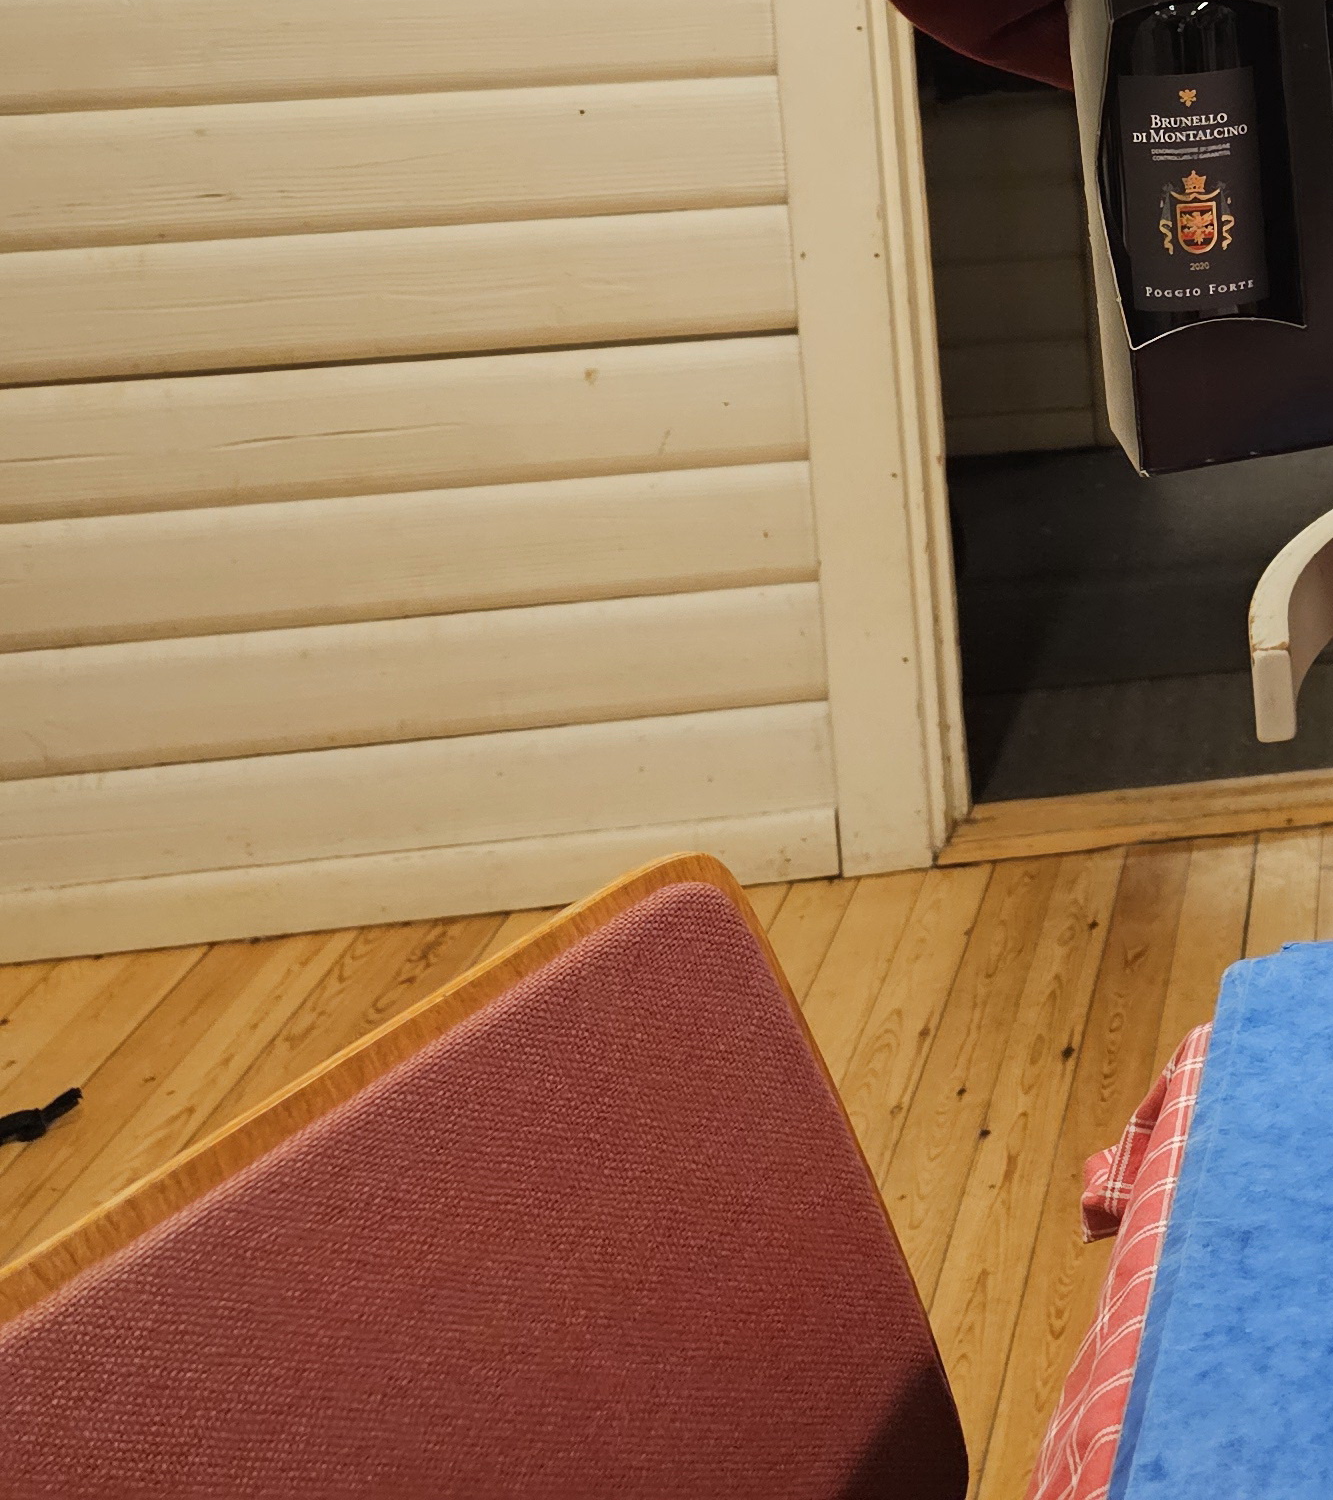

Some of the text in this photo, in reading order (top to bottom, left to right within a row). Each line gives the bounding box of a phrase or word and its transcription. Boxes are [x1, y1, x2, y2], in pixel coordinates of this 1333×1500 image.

[1150, 112, 1228, 129] BRUNELLO
[1133, 124, 1248, 143] DI MONTALCINO
[1190, 262, 1210, 271] 2020
[1145, 279, 1254, 298] POGGIO FORTE
